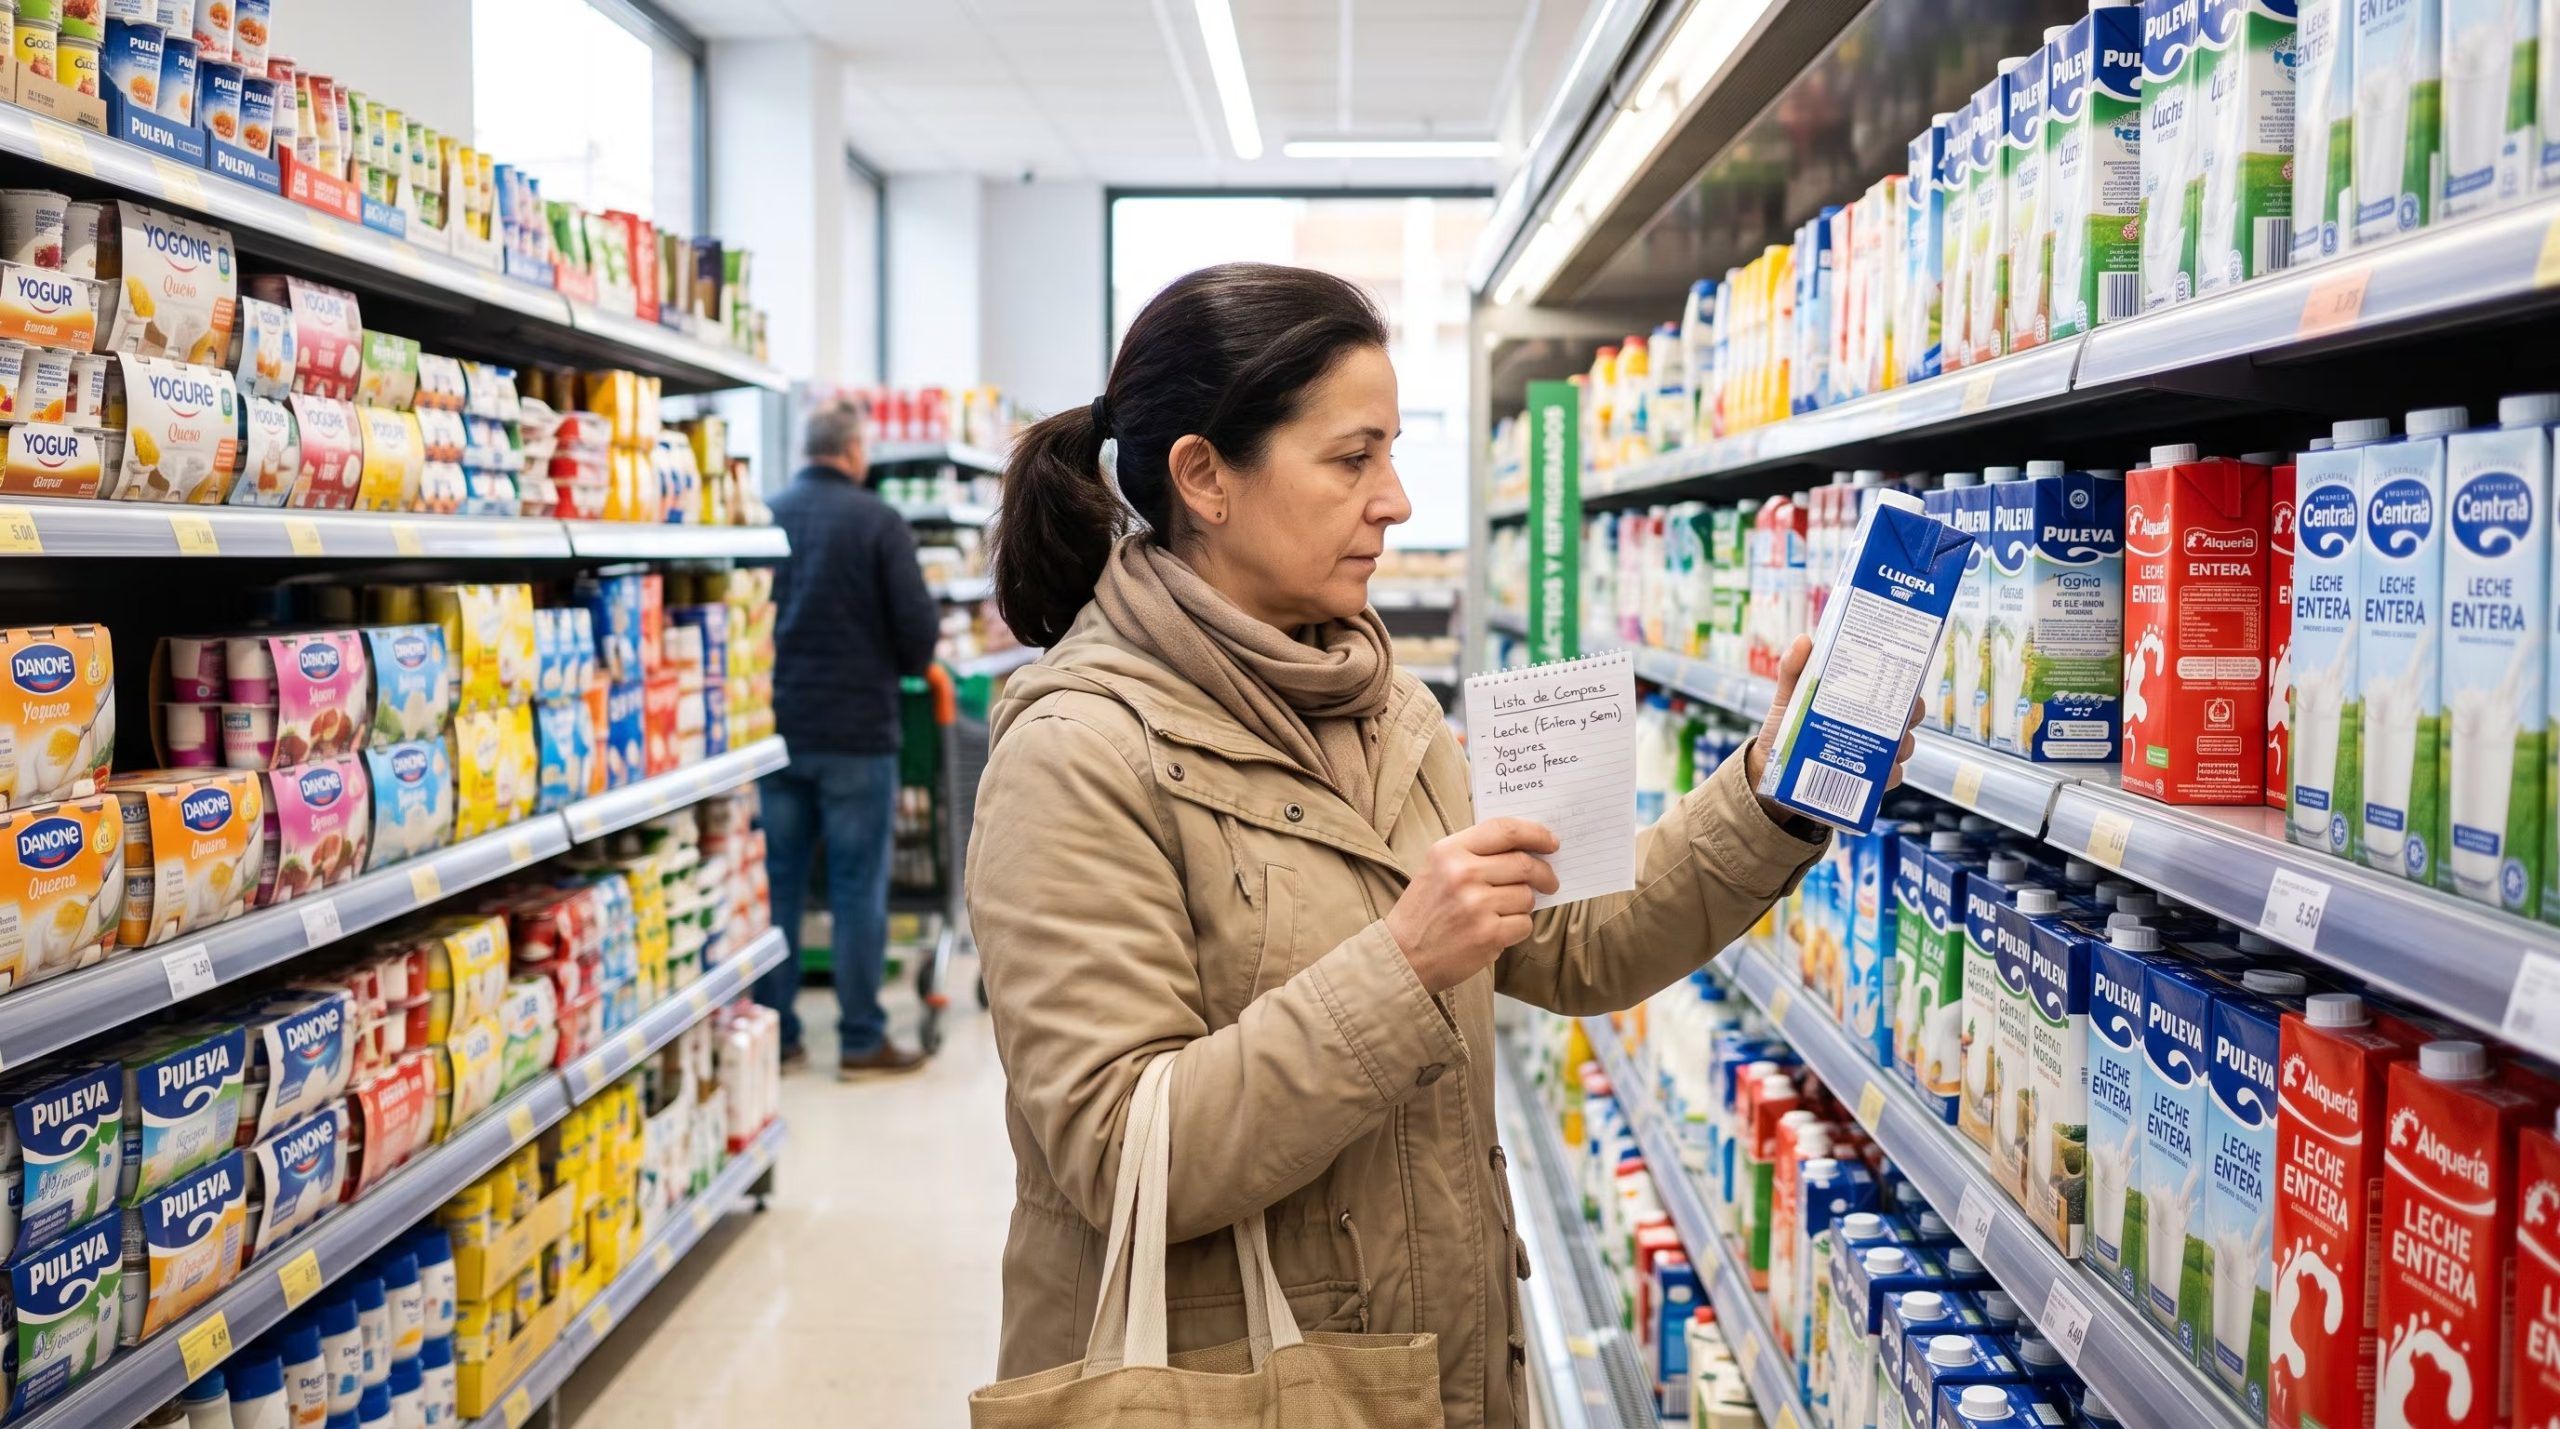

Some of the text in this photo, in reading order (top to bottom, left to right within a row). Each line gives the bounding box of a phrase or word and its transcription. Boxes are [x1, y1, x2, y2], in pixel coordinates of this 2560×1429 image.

[2103, 50, 2141, 67] PUL
[131, 117, 174, 148] PULEVA
[217, 150, 256, 179] PULEVA
[17, 275, 73, 307] YOGUR
[23, 433, 78, 458] YOGUR
[1955, 508, 1990, 532] PULEVA
[1994, 506, 2034, 531] PULEVA
[2043, 526, 2114, 543] PULEVA
[2140, 564, 2165, 580] LECHE
[2189, 563, 2252, 576] ENTERA
[2309, 575, 2343, 592] LECHE
[2379, 576, 2416, 595] LECHE
[2132, 584, 2166, 604] ENTERA
[2468, 577, 2512, 598] LECHE
[2296, 596, 2352, 621] ENTERA
[2365, 598, 2426, 626] ENTERA
[2450, 601, 2526, 632] ENTERA
[16, 656, 71, 677] DANONE
[1493, 695, 1526, 710] Lista
[1533, 690, 1550, 704] de
[1493, 725, 1530, 739] Leche
[1580, 718, 1587, 731] y
[1590, 703, 1623, 724] Semi)
[1495, 761, 1537, 777] Queso
[1499, 778, 1544, 796] Huevos
[20, 825, 80, 856] DANONE
[1968, 894, 1996, 922] PULE
[2095, 972, 2142, 1018] PULEVA
[286, 1007, 340, 1051] DANONE
[2148, 1002, 2203, 1053] PULEVA
[158, 1045, 229, 1097] PULEVA
[2100, 1056, 2130, 1088] LECHE
[2216, 1036, 2275, 1092] PULEVA
[32, 1080, 110, 1135] PULEVA
[2092, 1076, 2132, 1115] ENTERA
[2154, 1092, 2190, 1129] LECHE
[2303, 1074, 2359, 1123] Alquería
[281, 1119, 333, 1168] DANONE
[2147, 1113, 2192, 1158] ENTERA
[2222, 1132, 2262, 1174] LECHE
[2293, 1134, 2345, 1189] LECHE
[2415, 1130, 2490, 1190] Alquería
[2214, 1154, 2263, 1203] ENTERA
[161, 1169, 232, 1228] PULEVA
[2283, 1163, 2349, 1232] ENTERA
[2403, 1198, 2472, 1263] LECHE
[30, 1232, 110, 1296] PULEVA
[2391, 1230, 2478, 1309] ENTERA
